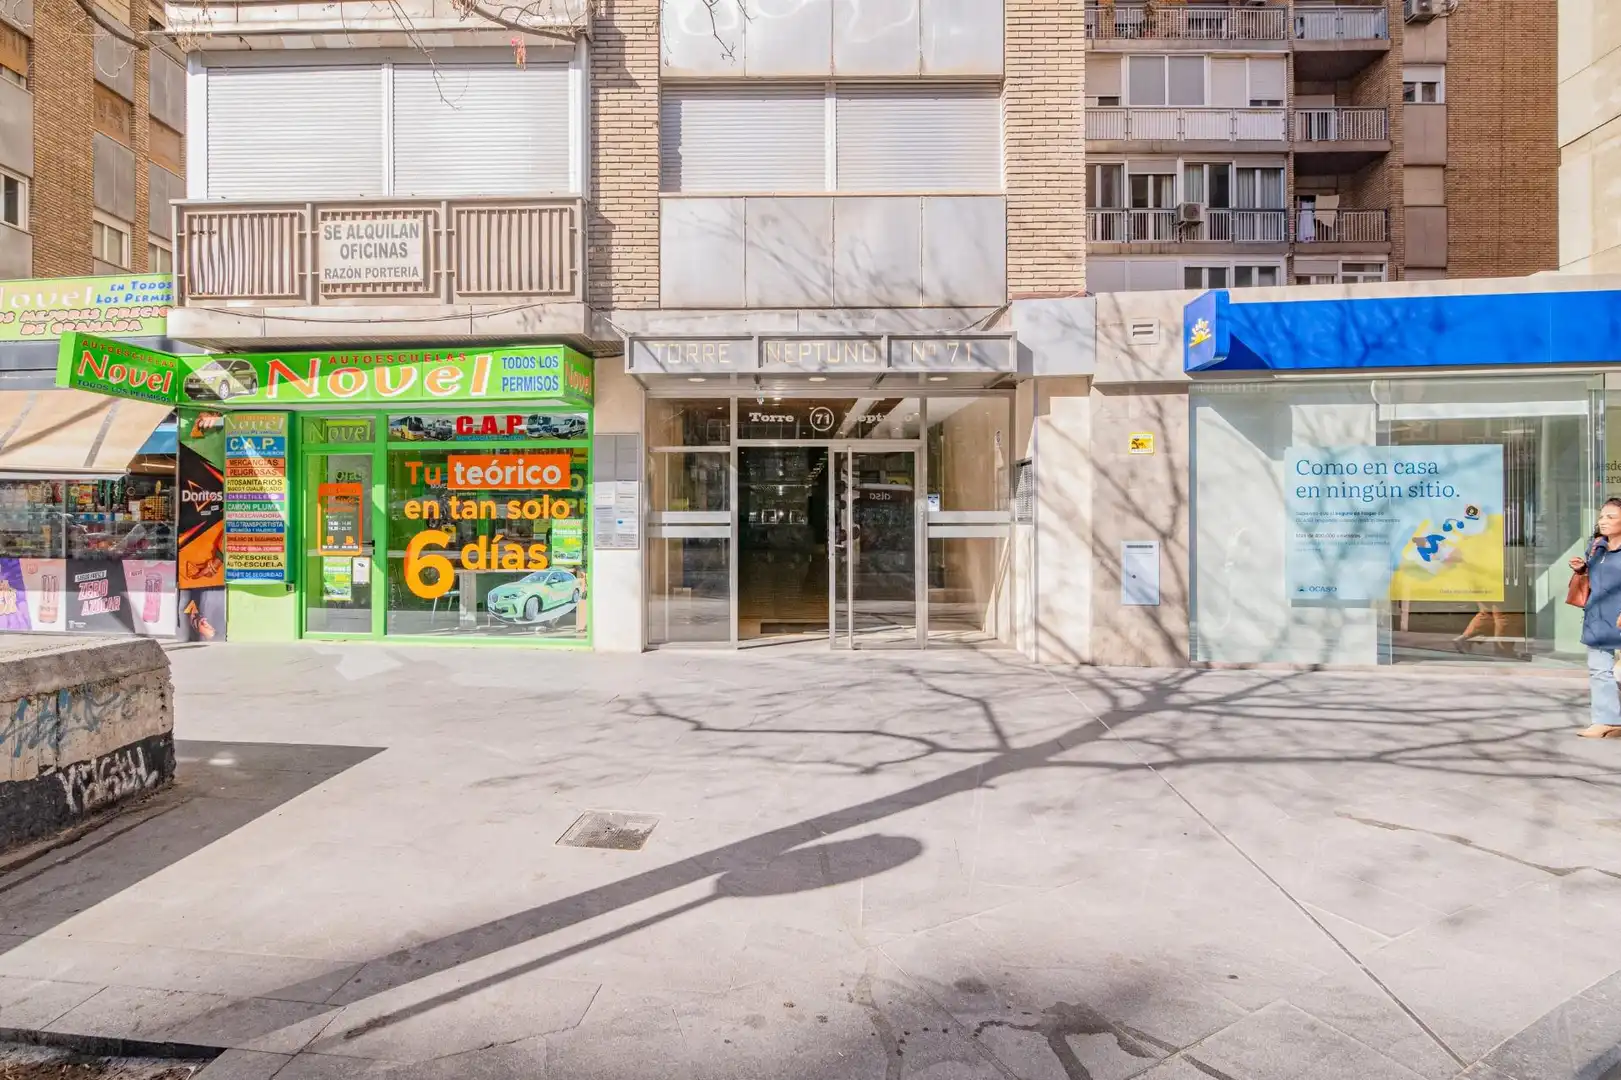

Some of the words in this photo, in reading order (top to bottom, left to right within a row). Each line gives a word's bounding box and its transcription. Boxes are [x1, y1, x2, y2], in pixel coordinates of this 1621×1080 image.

[324, 225, 342, 240] SE
[346, 223, 419, 240] ALQUILAN
[340, 242, 408, 260] OFICINAS
[324, 265, 361, 279] RAZÓN
[0, 286, 93, 309] ovel
[125, 293, 174, 303] PERMIS
[19, 308, 101, 322] MEJORES
[105, 305, 172, 319] PRECIO
[20, 323, 47, 335] DE
[51, 319, 143, 335] GRANADA
[82, 340, 176, 368] AUTOESCUELAS
[329, 353, 466, 365] AUTOESCUELAS
[502, 356, 536, 370] TODOS
[540, 355, 558, 369] LOS
[653, 343, 731, 363] TORRE
[766, 342, 876, 363] NEPTUNO
[947, 342, 972, 363] 71
[78, 350, 173, 394] Novel
[266, 353, 493, 398] Novel
[78, 380, 109, 391] TODOS
[111, 386, 127, 394] LOS
[130, 391, 170, 402] PERMISOS
[502, 375, 558, 392] PERMISOS
[456, 415, 525, 435] C.A.P.
[749, 412, 794, 423] Torre
[815, 412, 831, 425] 71
[309, 420, 371, 443] Novel
[405, 461, 441, 485] Tu
[454, 458, 562, 485] teórico
[1296, 459, 1358, 476] Como
[1363, 463, 1388, 475] en
[1394, 462, 1439, 475] casa
[182, 490, 223, 502] Doritos
[1296, 485, 1320, 498] en
[1326, 481, 1403, 502] ningún
[1408, 481, 1460, 498] sitio.
[404, 500, 440, 519] en
[451, 495, 497, 519] tan
[507, 494, 570, 519] solo
[403, 530, 455, 599] 6
[461, 535, 548, 570] días
[77, 579, 109, 600] ZERO
